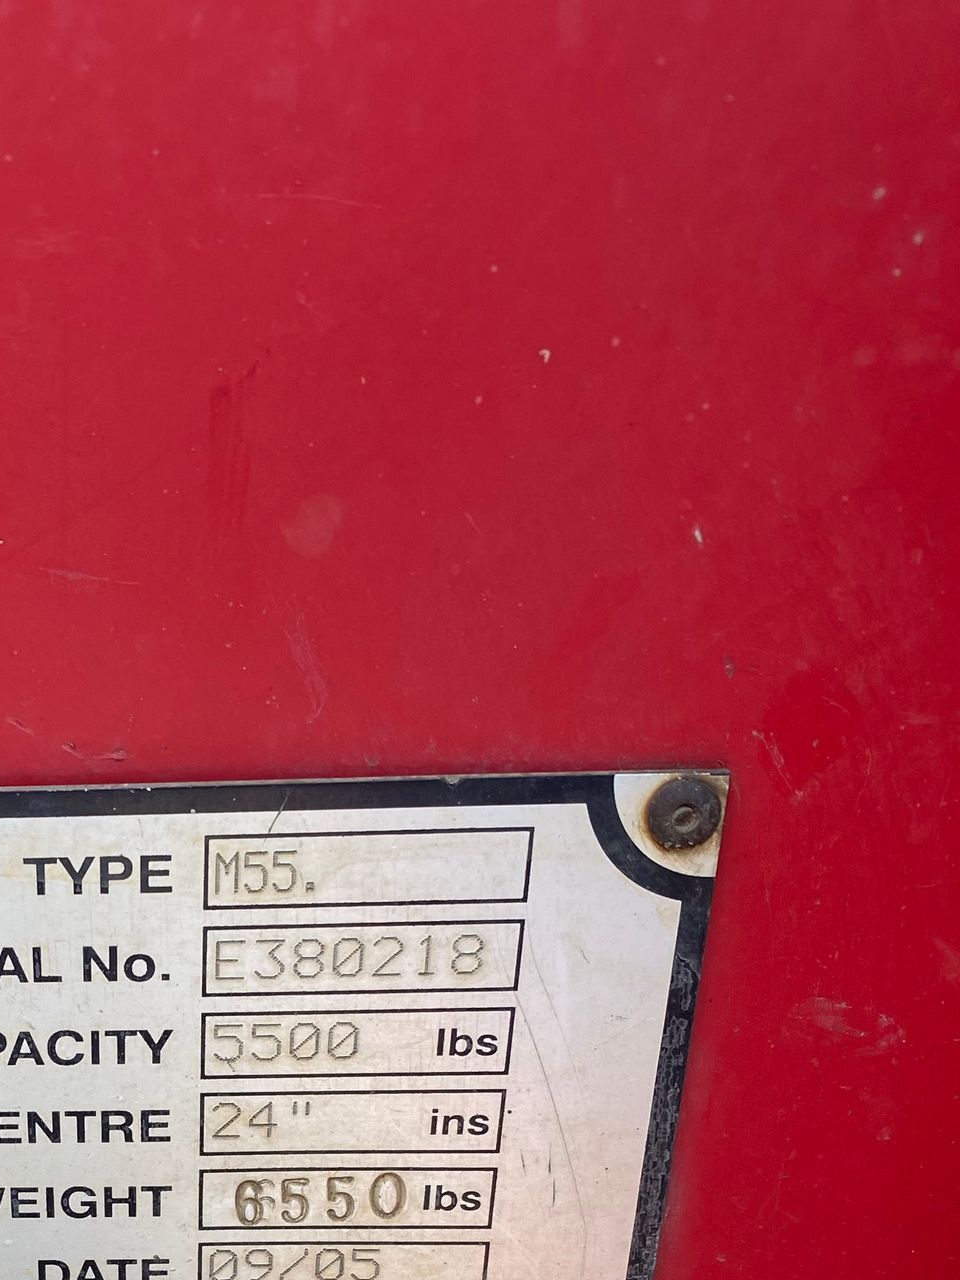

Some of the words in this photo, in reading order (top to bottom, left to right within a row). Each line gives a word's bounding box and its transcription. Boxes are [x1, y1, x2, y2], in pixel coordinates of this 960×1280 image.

[23, 855, 173, 896] TYPE
[82, 946, 171, 982] No.
[214, 934, 486, 981] E380218
[213, 1022, 359, 1063] 5500
[436, 1028, 498, 1057] lbs
[430, 1109, 490, 1136] ins
[235, 1172, 407, 1225] 6550
[422, 1187, 482, 1211] lbs
